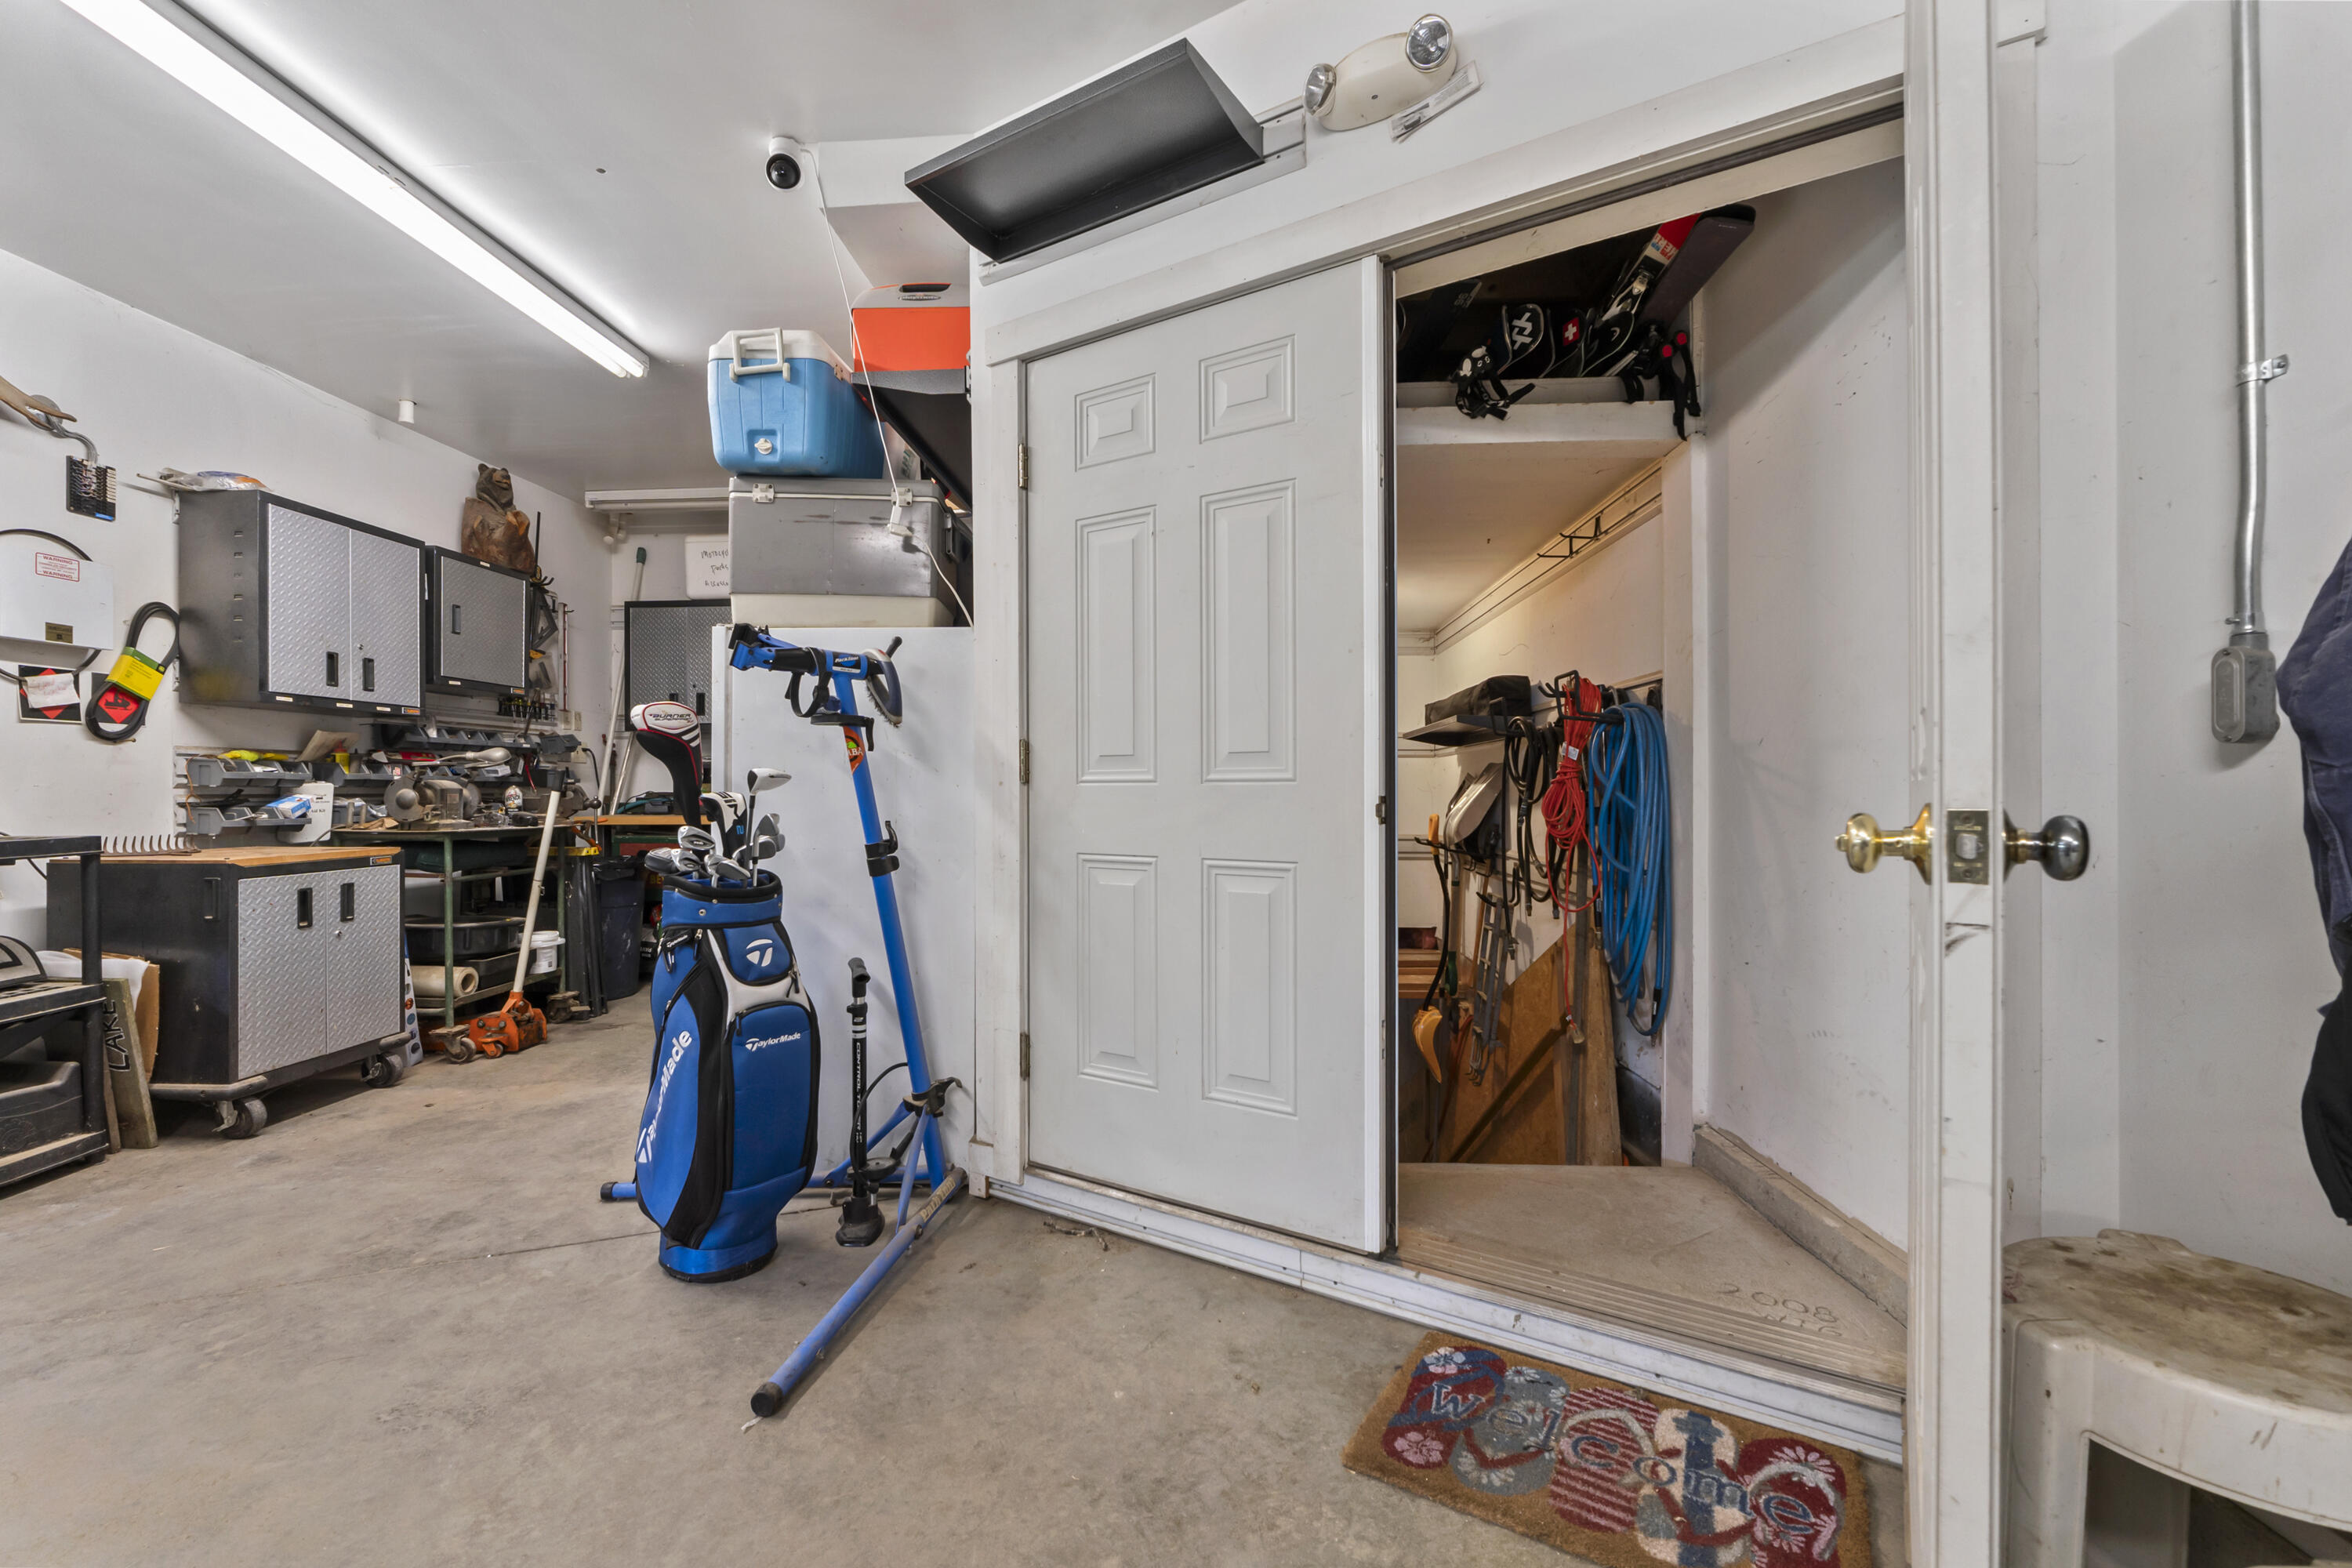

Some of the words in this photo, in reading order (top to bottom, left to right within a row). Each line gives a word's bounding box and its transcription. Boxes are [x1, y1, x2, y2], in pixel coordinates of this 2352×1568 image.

[42, 555, 73, 564] WARNING
[42, 570, 73, 579] WARNING
[103, 1000, 130, 1072] LAKE
[745, 1032, 801, 1052] TaylorMade
[1716, 1283, 1838, 1323] 2008
